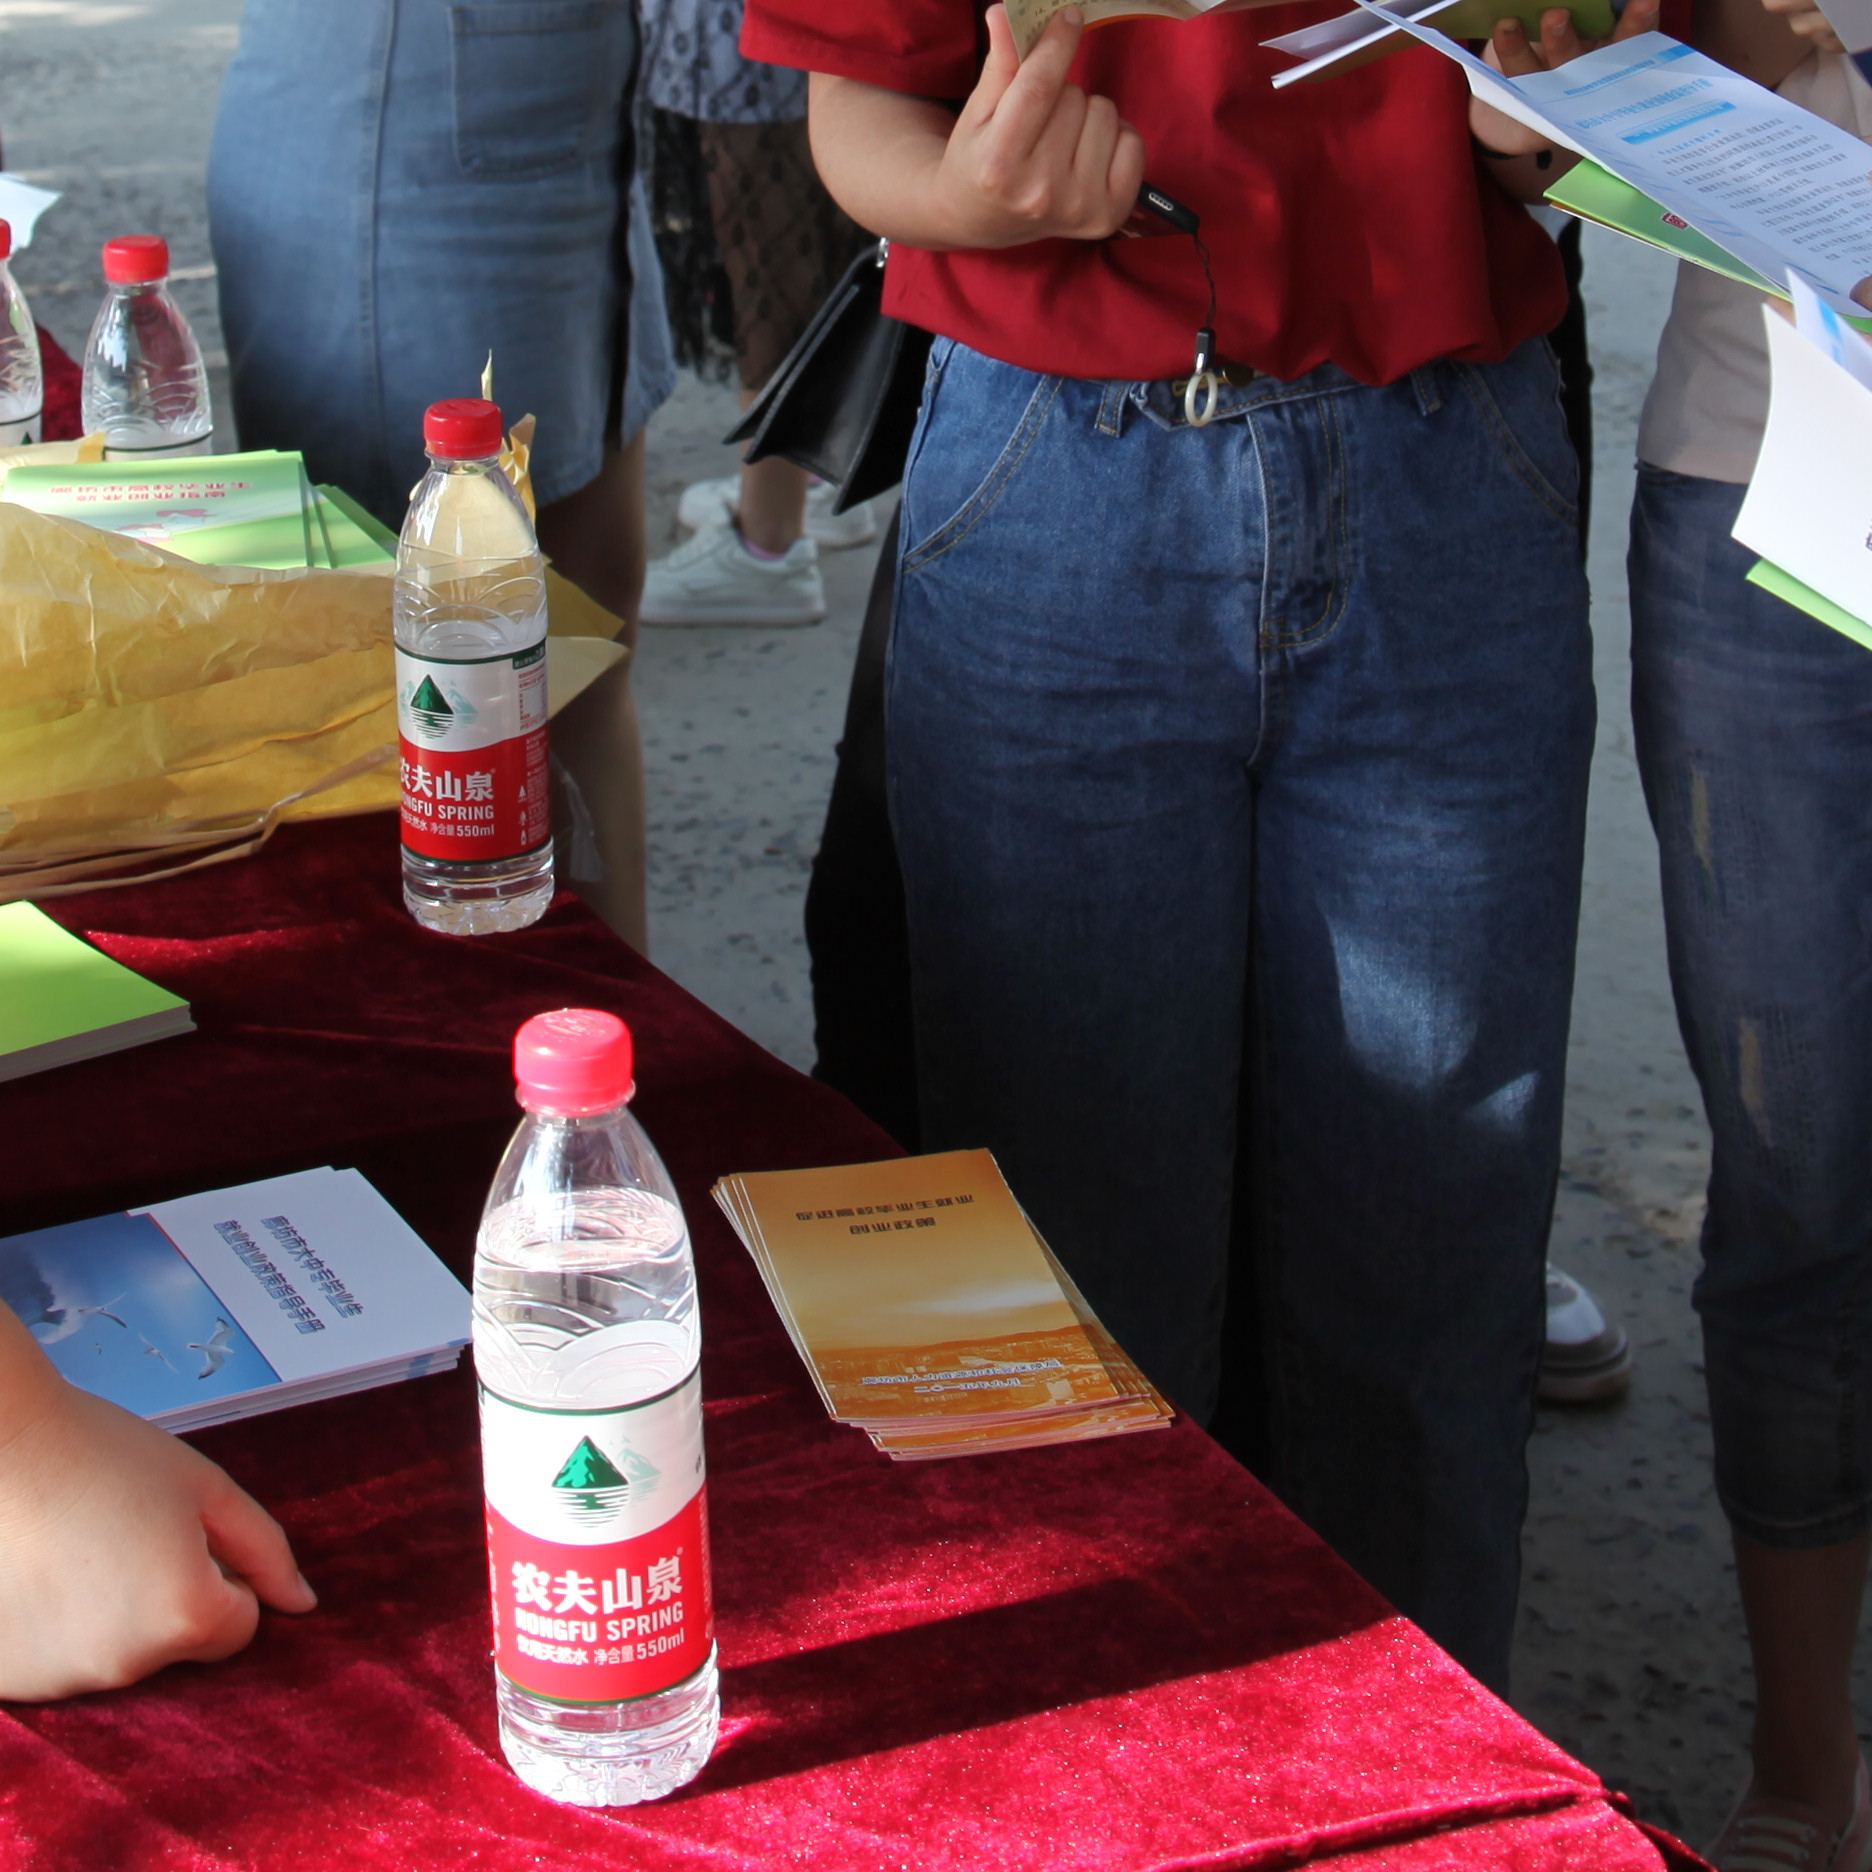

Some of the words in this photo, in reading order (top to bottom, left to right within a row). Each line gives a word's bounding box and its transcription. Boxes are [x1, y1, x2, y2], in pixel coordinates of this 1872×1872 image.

[438, 805, 494, 821] SPRING
[260, 1215, 364, 1319] 廊坊市大中专毕业生
[512, 1556, 684, 1615] 农夫山泉
[515, 1607, 597, 1643] NONGFU
[607, 1602, 684, 1641] SPRING
